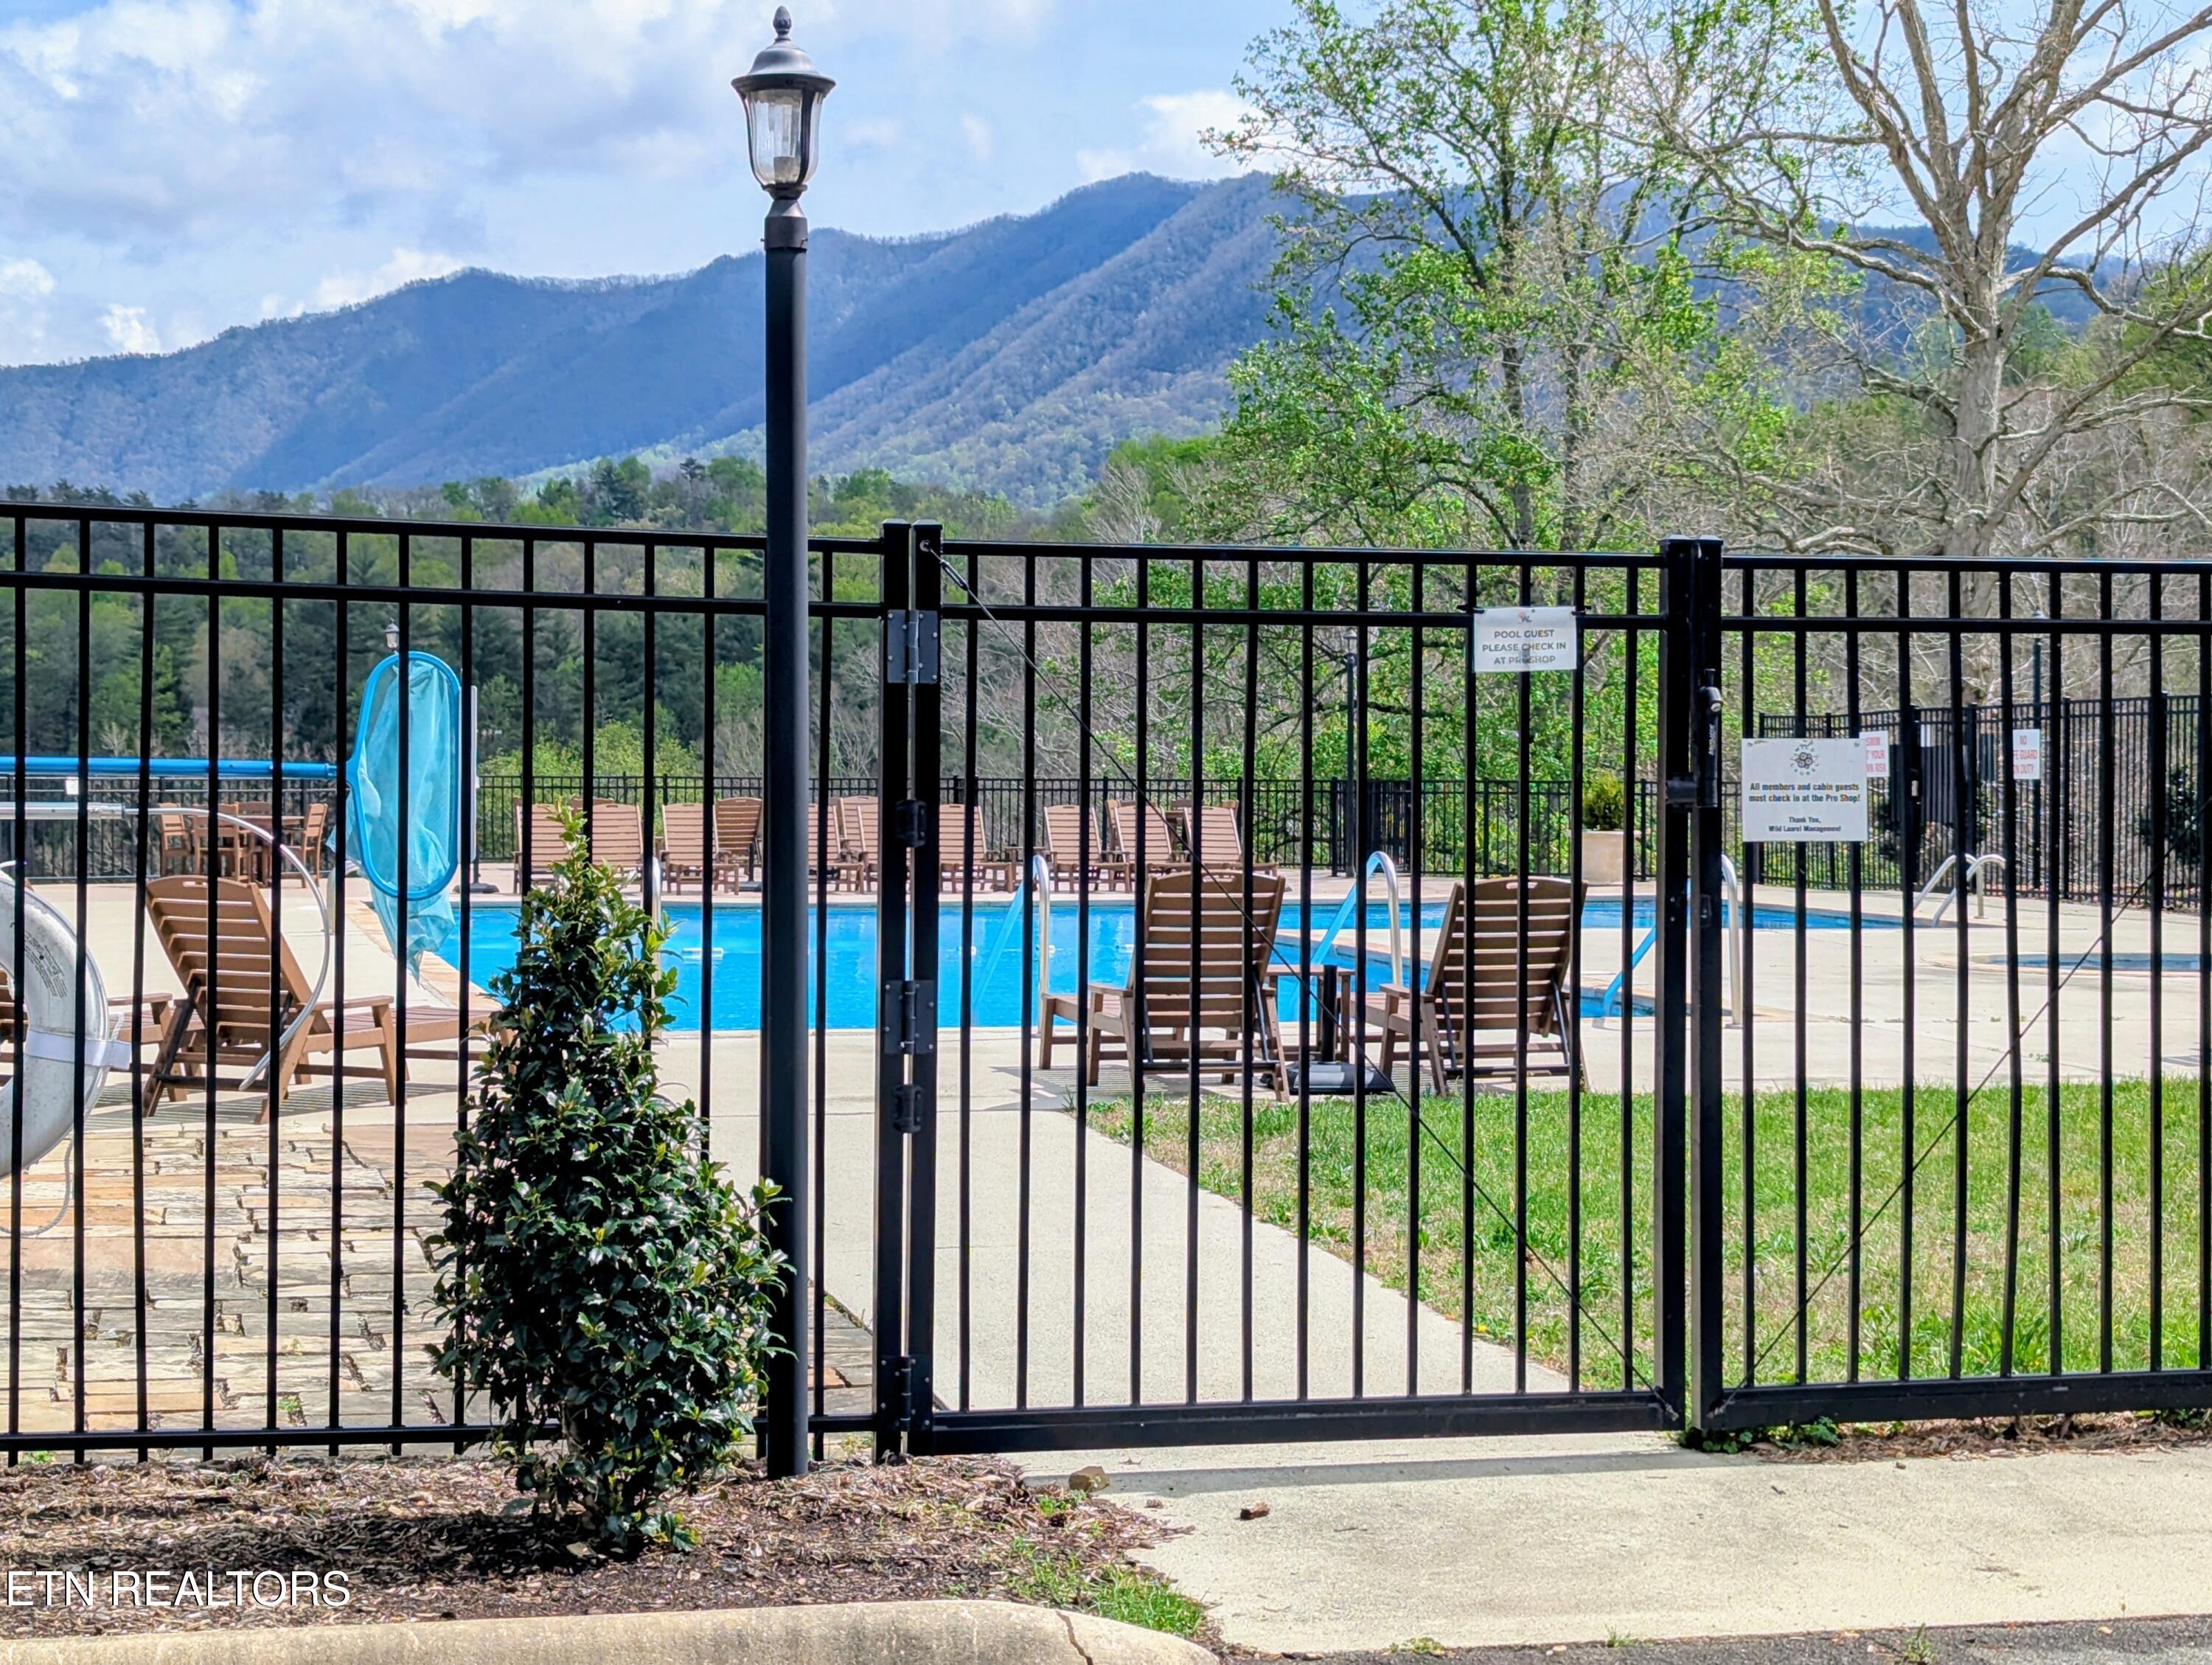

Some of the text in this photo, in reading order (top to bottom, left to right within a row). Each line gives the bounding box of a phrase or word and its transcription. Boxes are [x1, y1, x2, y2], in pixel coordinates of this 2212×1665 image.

[1494, 629, 1555, 639] POOL GUEST
[1482, 644, 1518, 652] PLEASE
[1522, 642, 1554, 651] CHECK
[1494, 657, 1506, 665] AT
[1871, 750, 1885, 759] YOUR
[2020, 749, 2037, 759] GUARD
[2020, 764, 2034, 774] DUTY
[1835, 783, 1859, 792] guests
[1840, 794, 1860, 803] Shop!
[1804, 825, 1841, 833] Management
